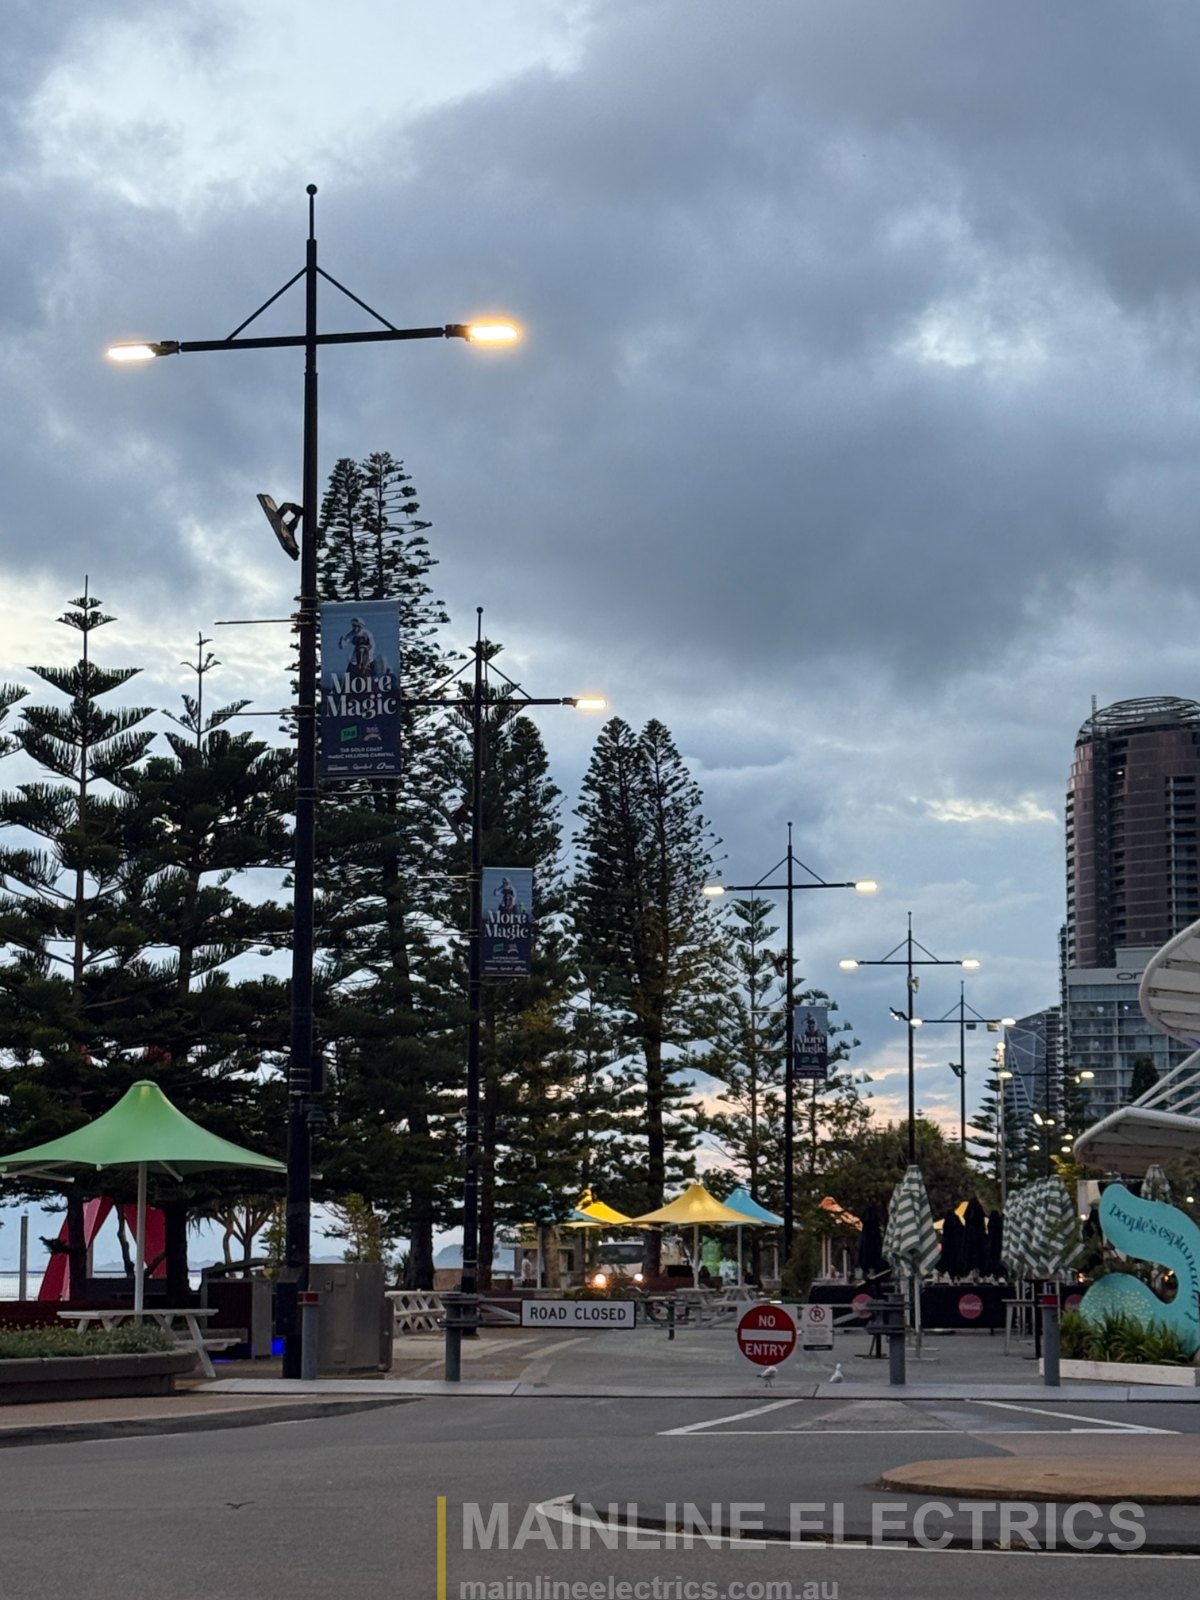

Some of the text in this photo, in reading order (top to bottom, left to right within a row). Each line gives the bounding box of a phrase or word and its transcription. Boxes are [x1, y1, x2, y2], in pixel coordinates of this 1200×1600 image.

[331, 672, 392, 694] More
[326, 693, 396, 719] Magic
[488, 910, 526, 924] More
[484, 923, 529, 940] Magic
[530, 1307, 626, 1321] ROAD CLOSED
[759, 1315, 776, 1327] NO
[745, 1343, 787, 1356] ENTRY
